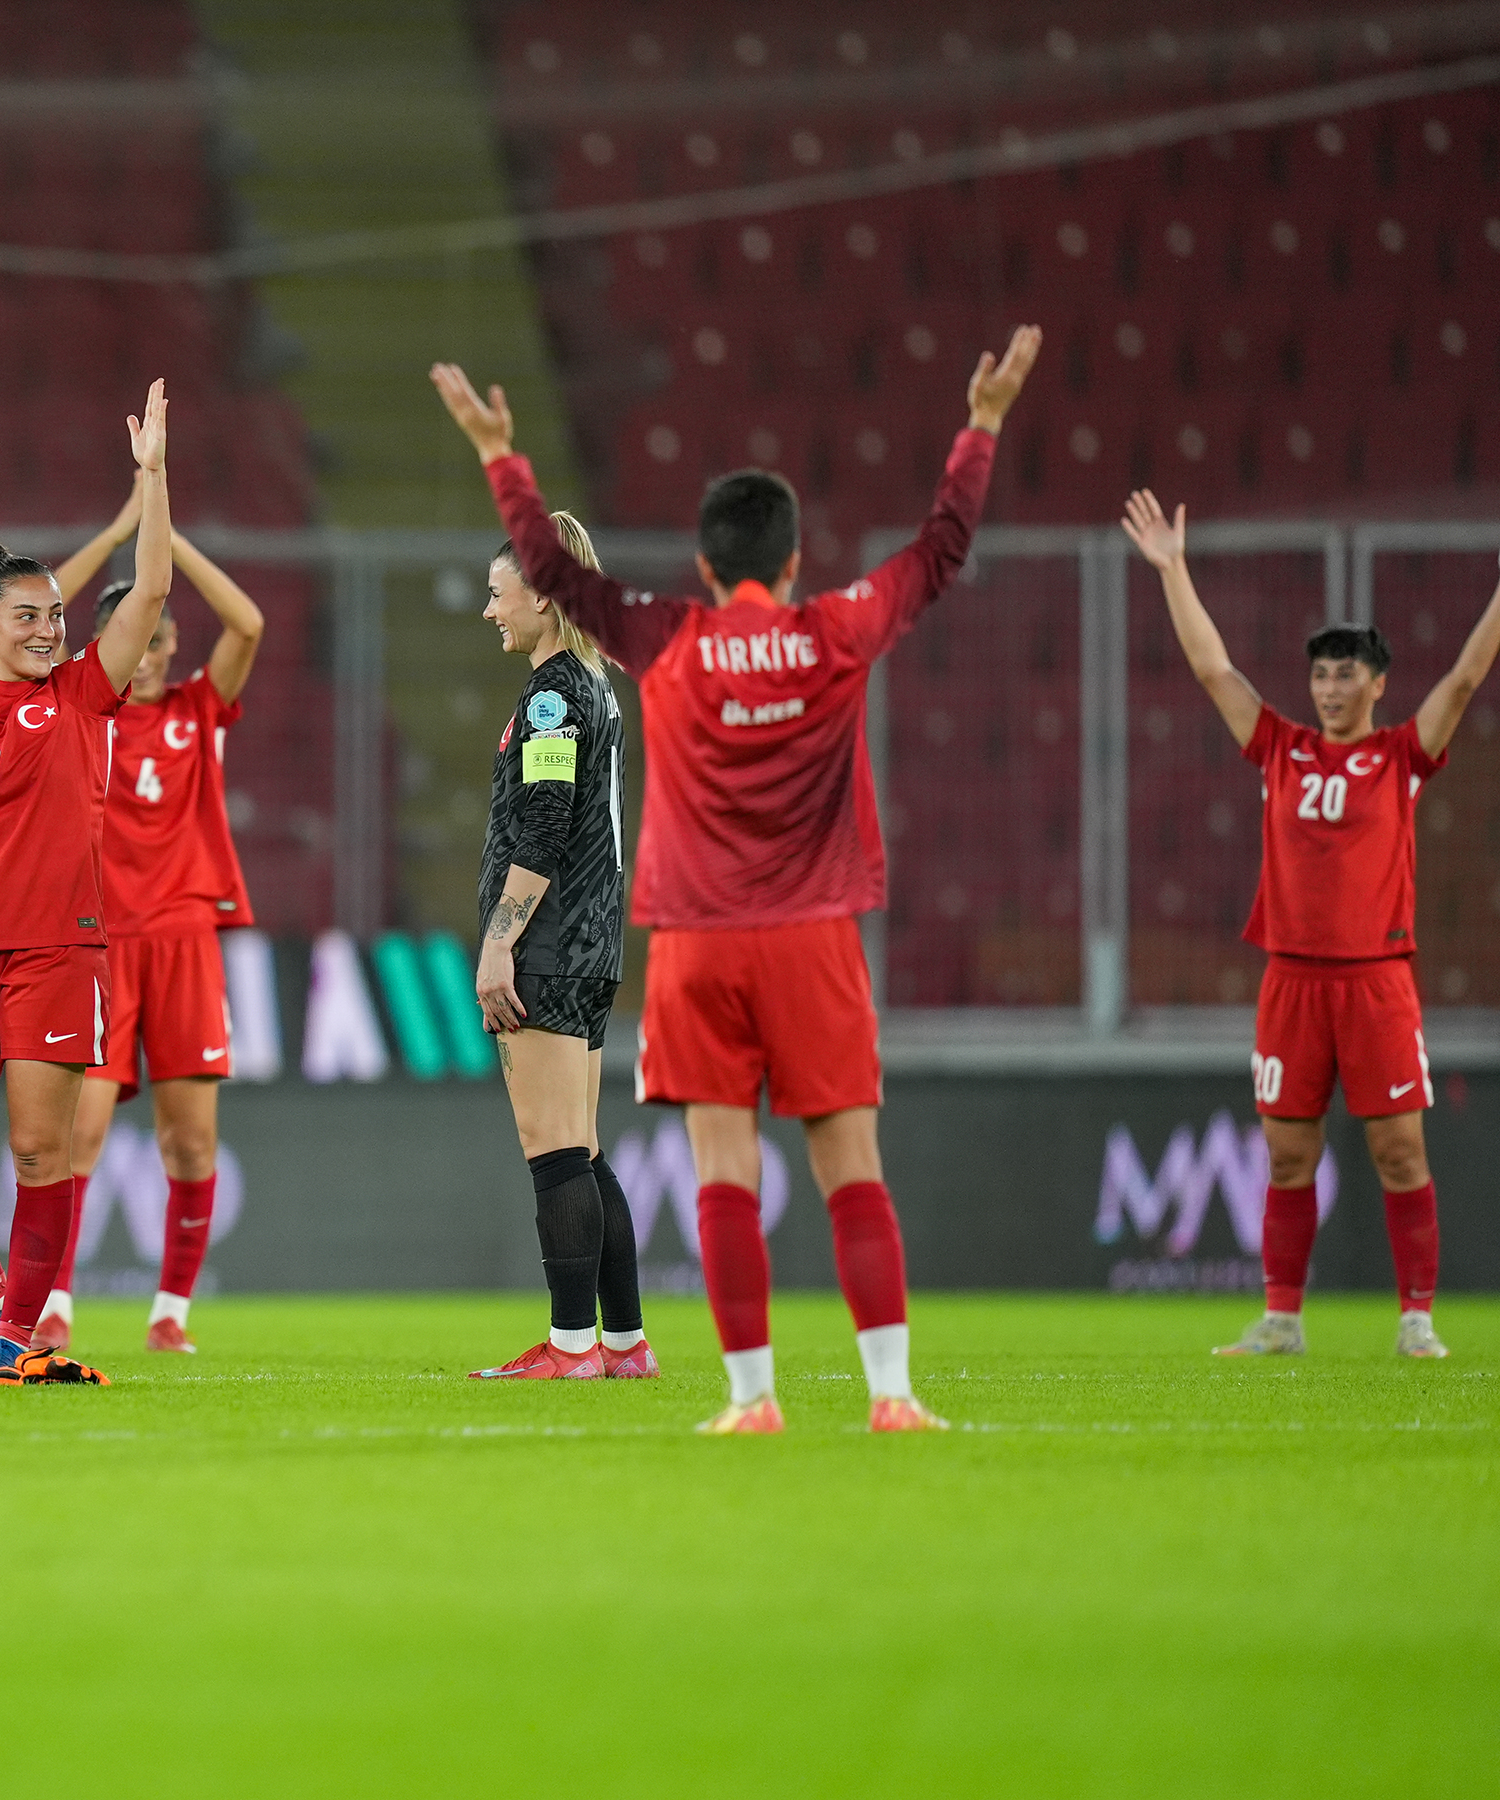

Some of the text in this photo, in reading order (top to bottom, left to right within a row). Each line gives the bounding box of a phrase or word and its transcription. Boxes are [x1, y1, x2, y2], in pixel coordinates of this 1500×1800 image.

[135, 757, 164, 803] 4
[544, 755, 576, 766] RESPEC
[1297, 772, 1348, 823] 20
[1251, 1050, 1285, 1105] 20
